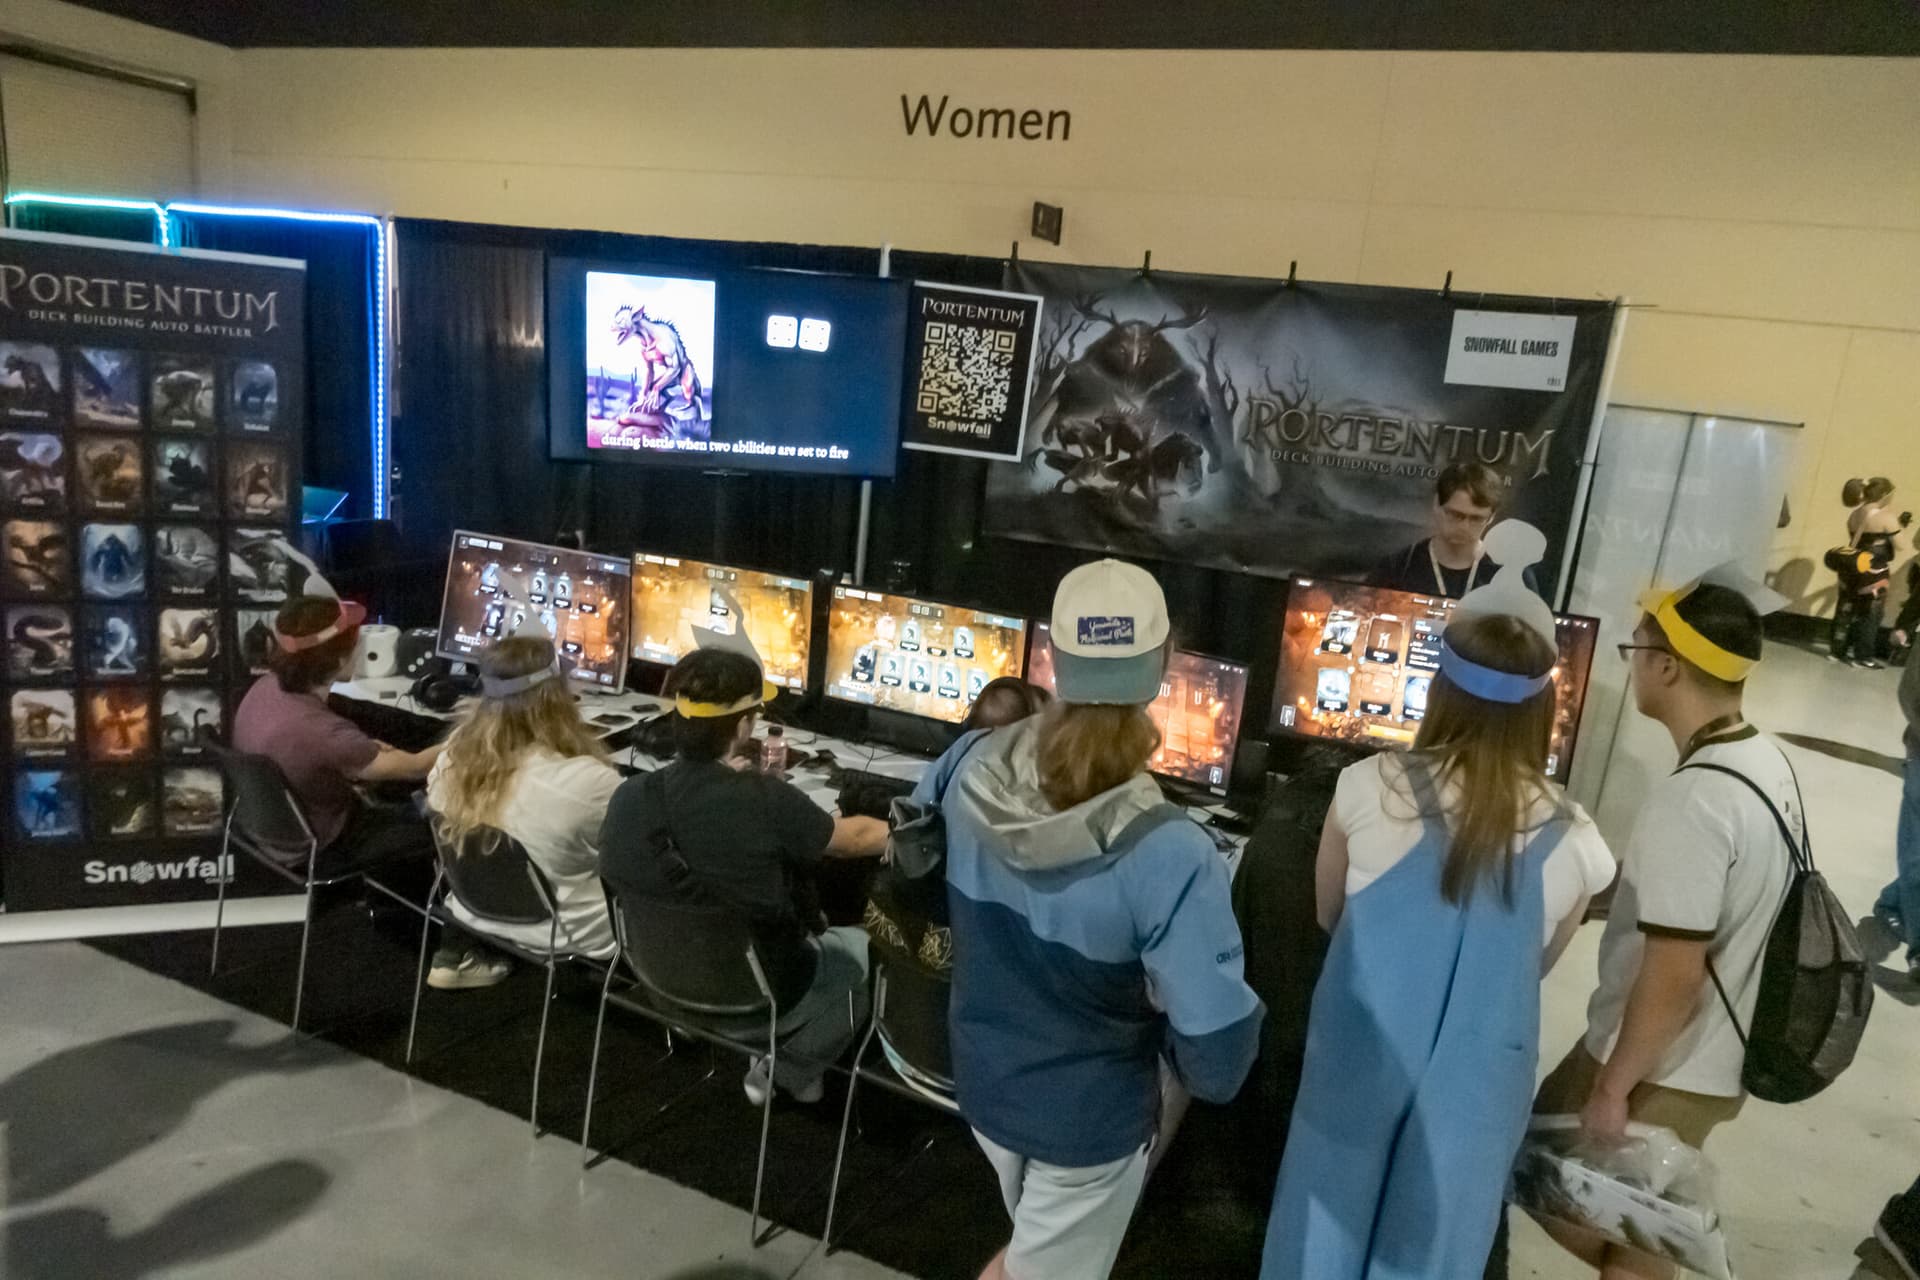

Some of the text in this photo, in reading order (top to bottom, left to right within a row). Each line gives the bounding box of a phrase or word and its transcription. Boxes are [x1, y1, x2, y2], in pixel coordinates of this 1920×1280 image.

[901, 94, 1071, 141] Women
[0, 264, 279, 332] PORTENTUM
[921, 297, 1026, 328] PORTENTUM
[28, 309, 252, 338] DECK BUILDING AUTO BATTLER
[1464, 336, 1559, 357] SNOWFALL GAMES
[601, 433, 849, 459] during battle when two abilities are set to fire
[1245, 398, 1556, 480] PORTENTUM
[1271, 450, 1439, 479] DECK BUILDING AUTO
